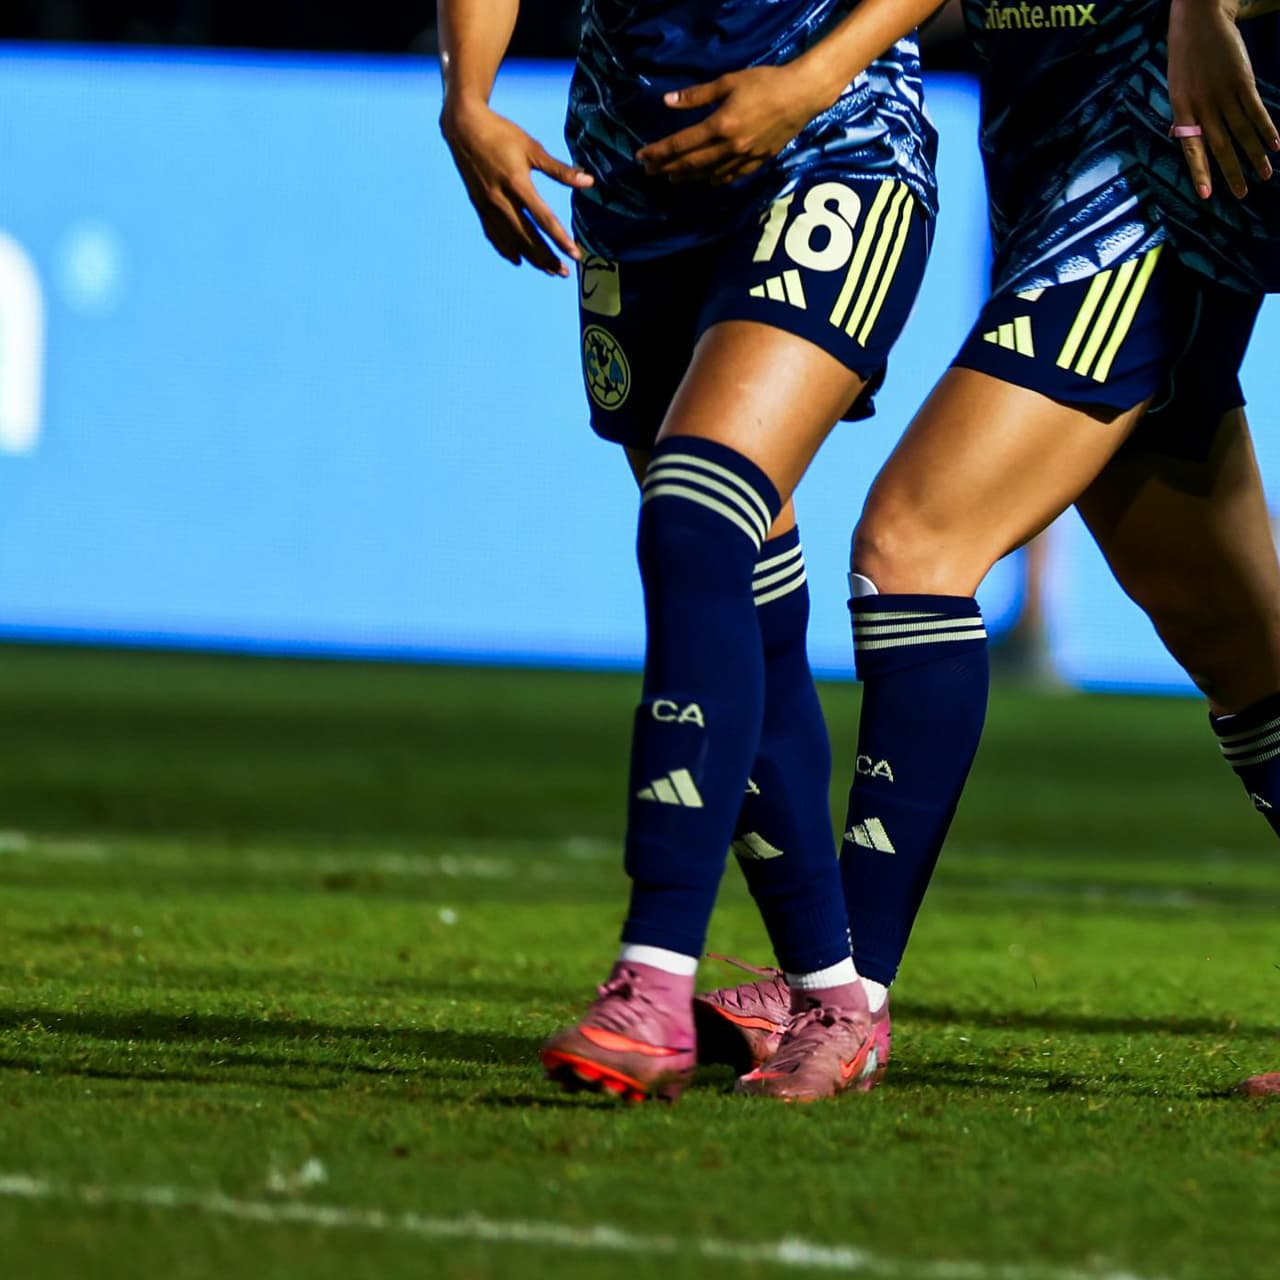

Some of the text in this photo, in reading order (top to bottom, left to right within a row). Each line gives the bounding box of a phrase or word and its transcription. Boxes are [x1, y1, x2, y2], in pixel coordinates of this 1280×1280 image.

[752, 181, 862, 272] 18
[651, 698, 705, 729] CA
[856, 754, 894, 784] CA
